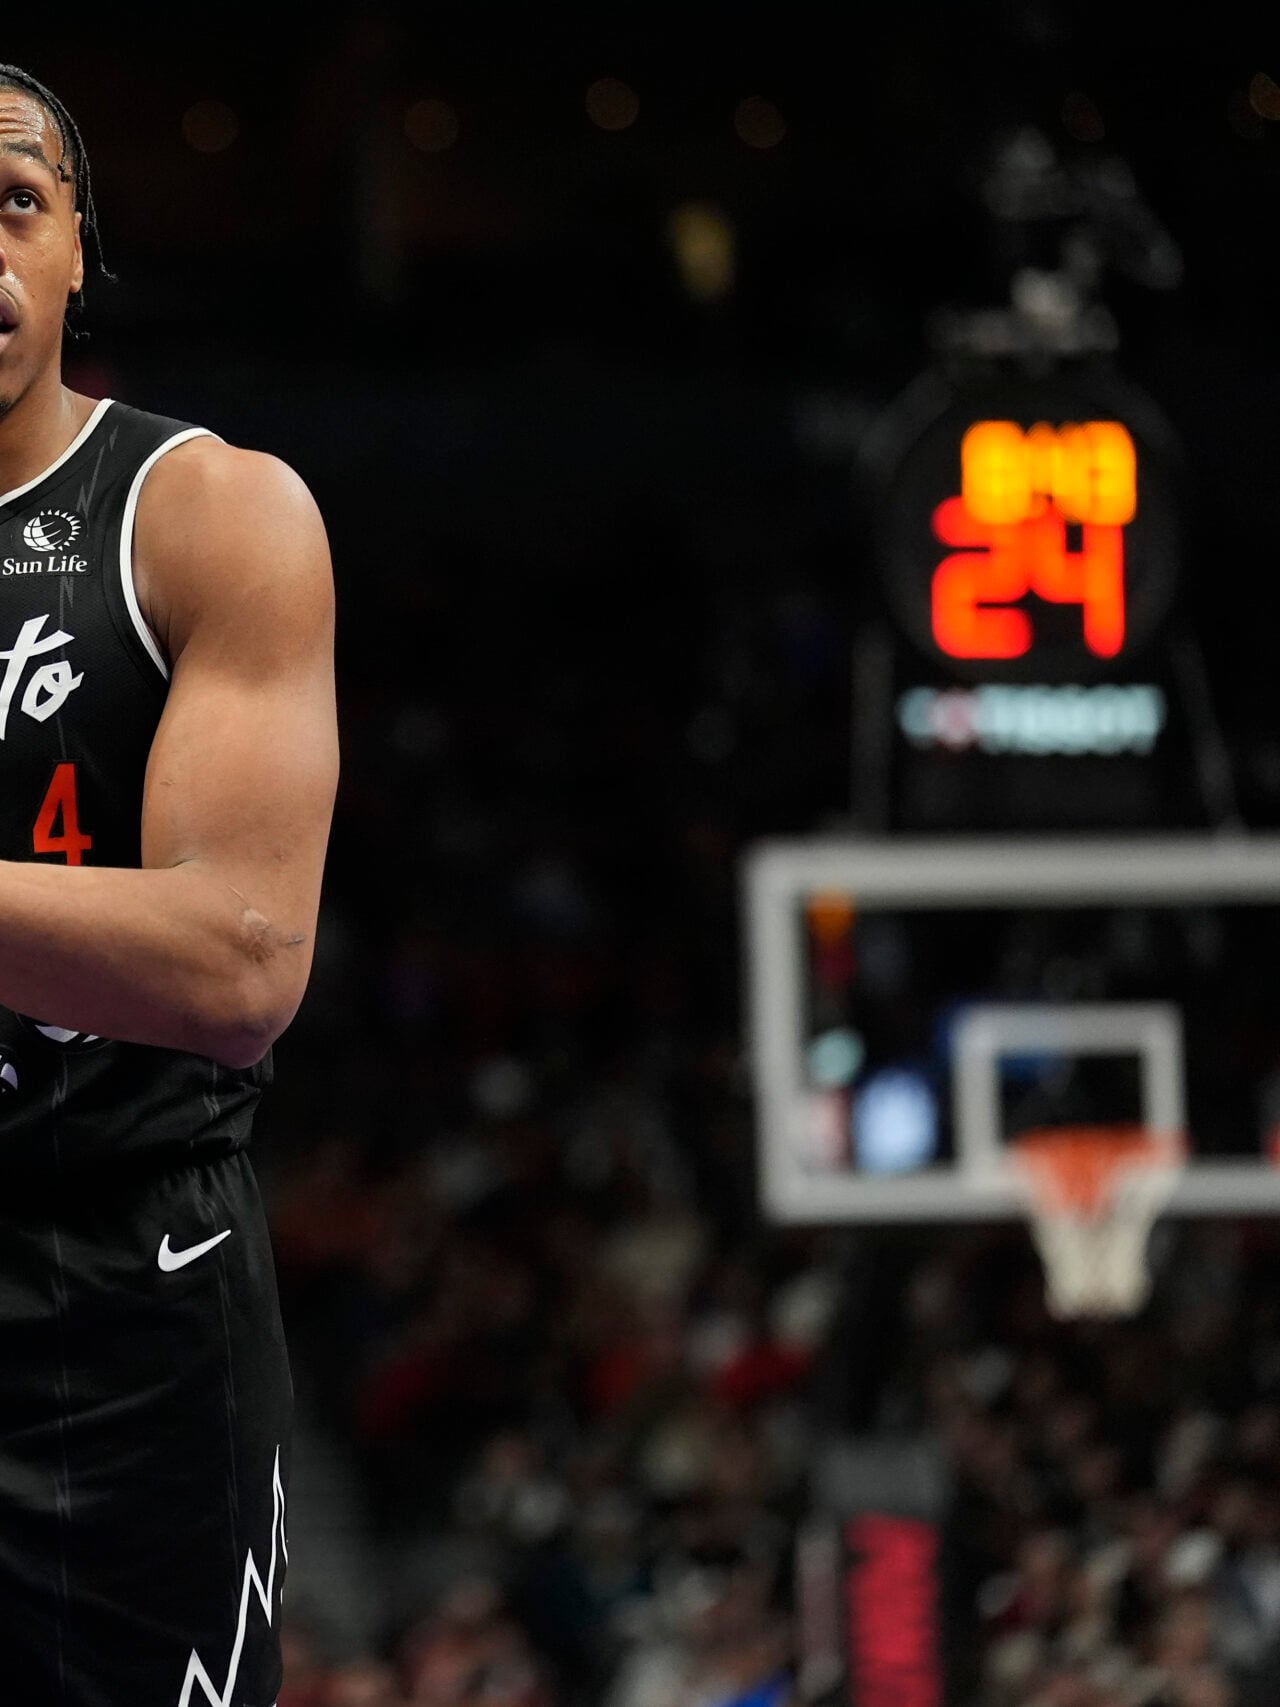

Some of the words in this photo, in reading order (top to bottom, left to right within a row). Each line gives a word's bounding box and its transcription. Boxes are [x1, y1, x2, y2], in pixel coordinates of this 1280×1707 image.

[2, 558, 43, 576] Sun
[46, 554, 88, 573] Life
[931, 496, 1125, 660] 24
[32, 763, 92, 867] 4
